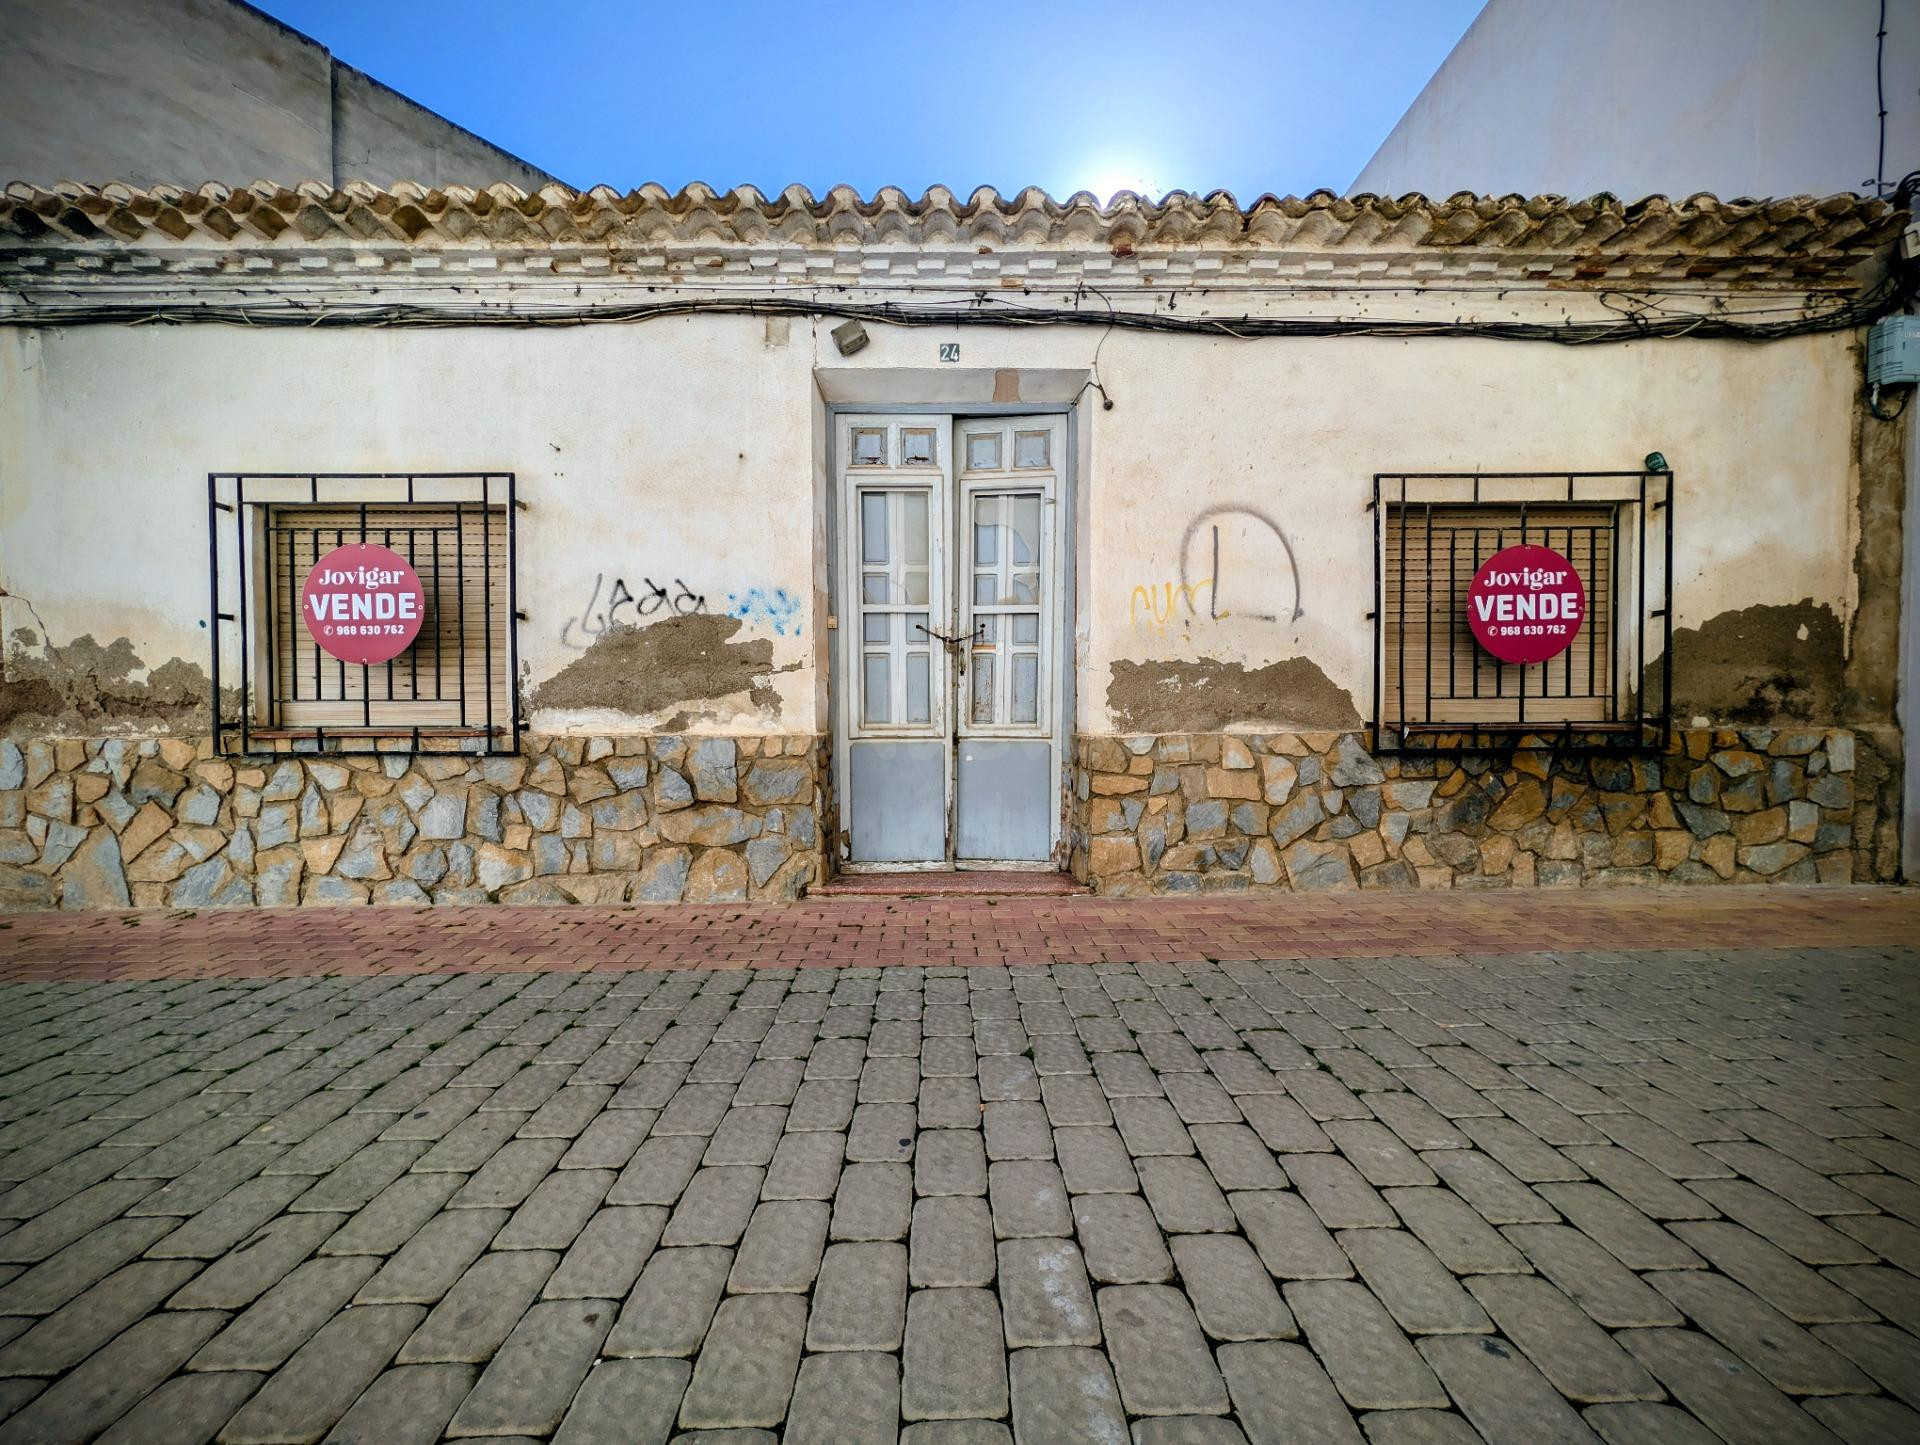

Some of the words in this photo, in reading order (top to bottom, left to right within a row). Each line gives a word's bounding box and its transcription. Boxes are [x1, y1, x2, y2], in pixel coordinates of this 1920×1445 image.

[941, 345, 959, 360] 24
[319, 566, 404, 589] Jovigar
[1484, 567, 1567, 590] Jovigar
[309, 592, 417, 621] VENDE
[1474, 593, 1578, 621] VENDE
[336, 625, 357, 636] 968
[360, 625, 381, 635] 630
[384, 624, 405, 635] 762
[1500, 626, 1521, 636] 968
[1523, 625, 1544, 636] 630
[1546, 624, 1567, 635] 762
